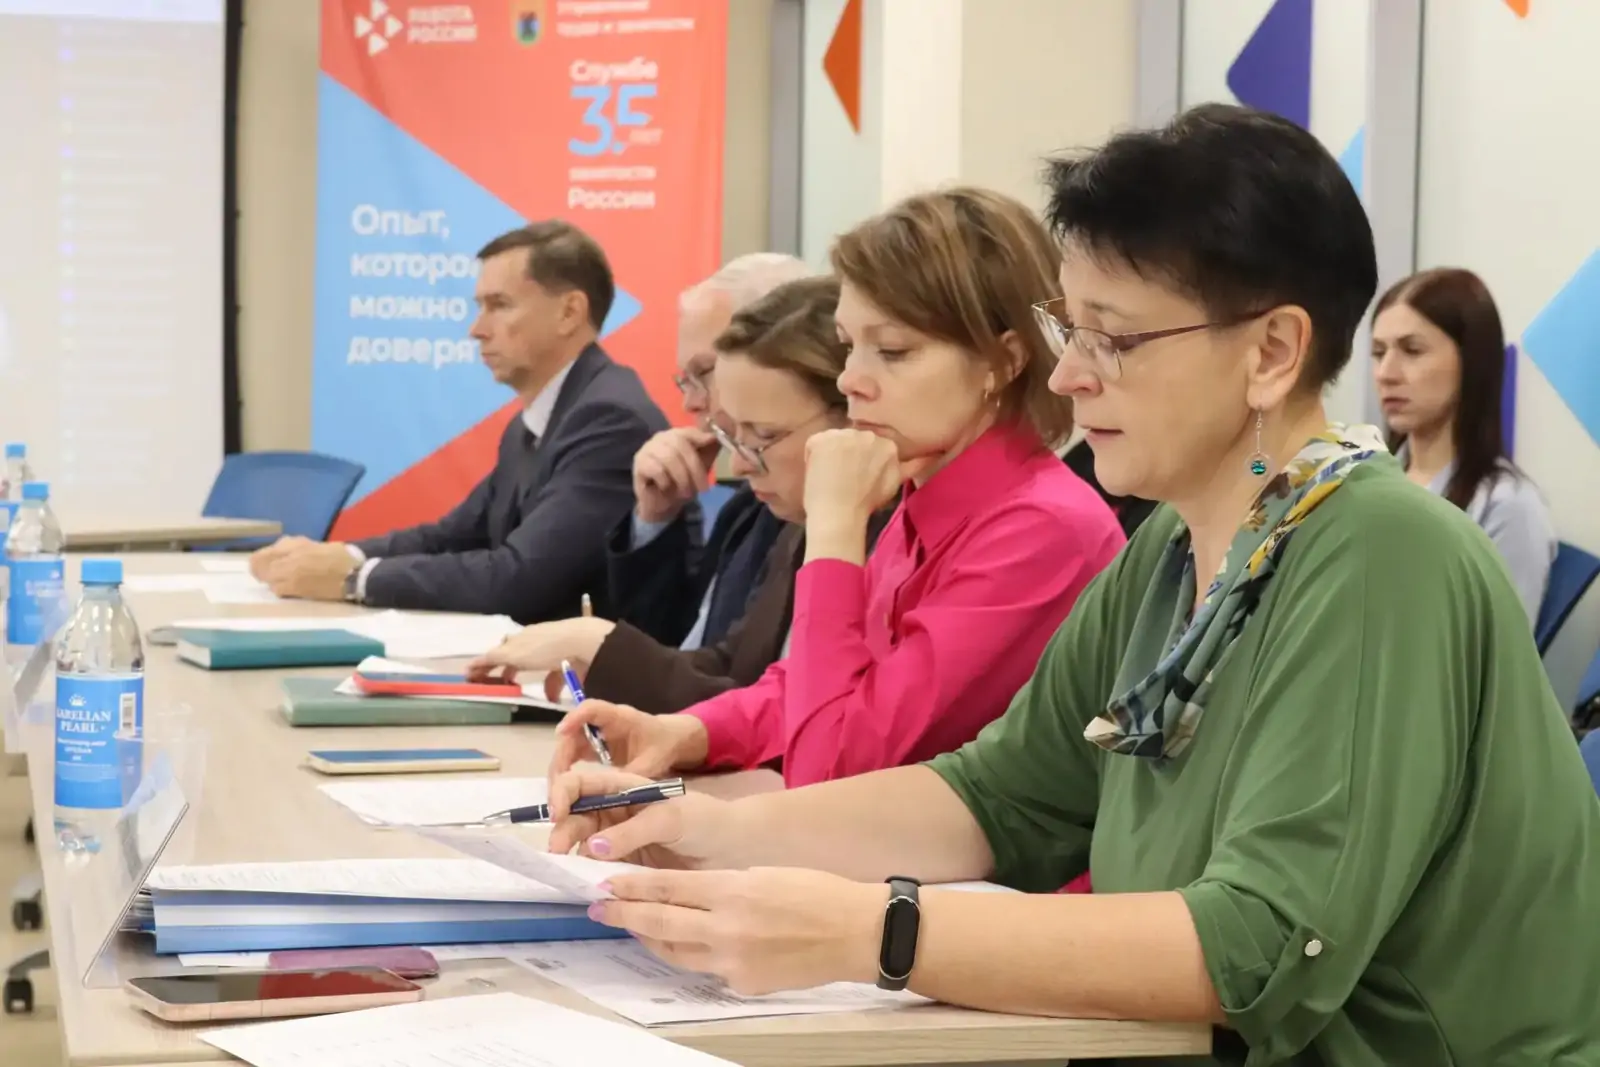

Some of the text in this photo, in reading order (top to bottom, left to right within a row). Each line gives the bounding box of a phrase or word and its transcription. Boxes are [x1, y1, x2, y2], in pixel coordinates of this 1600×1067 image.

[568, 187, 655, 210] России
[352, 204, 450, 240] Опыт,
[350, 296, 468, 322] можно
